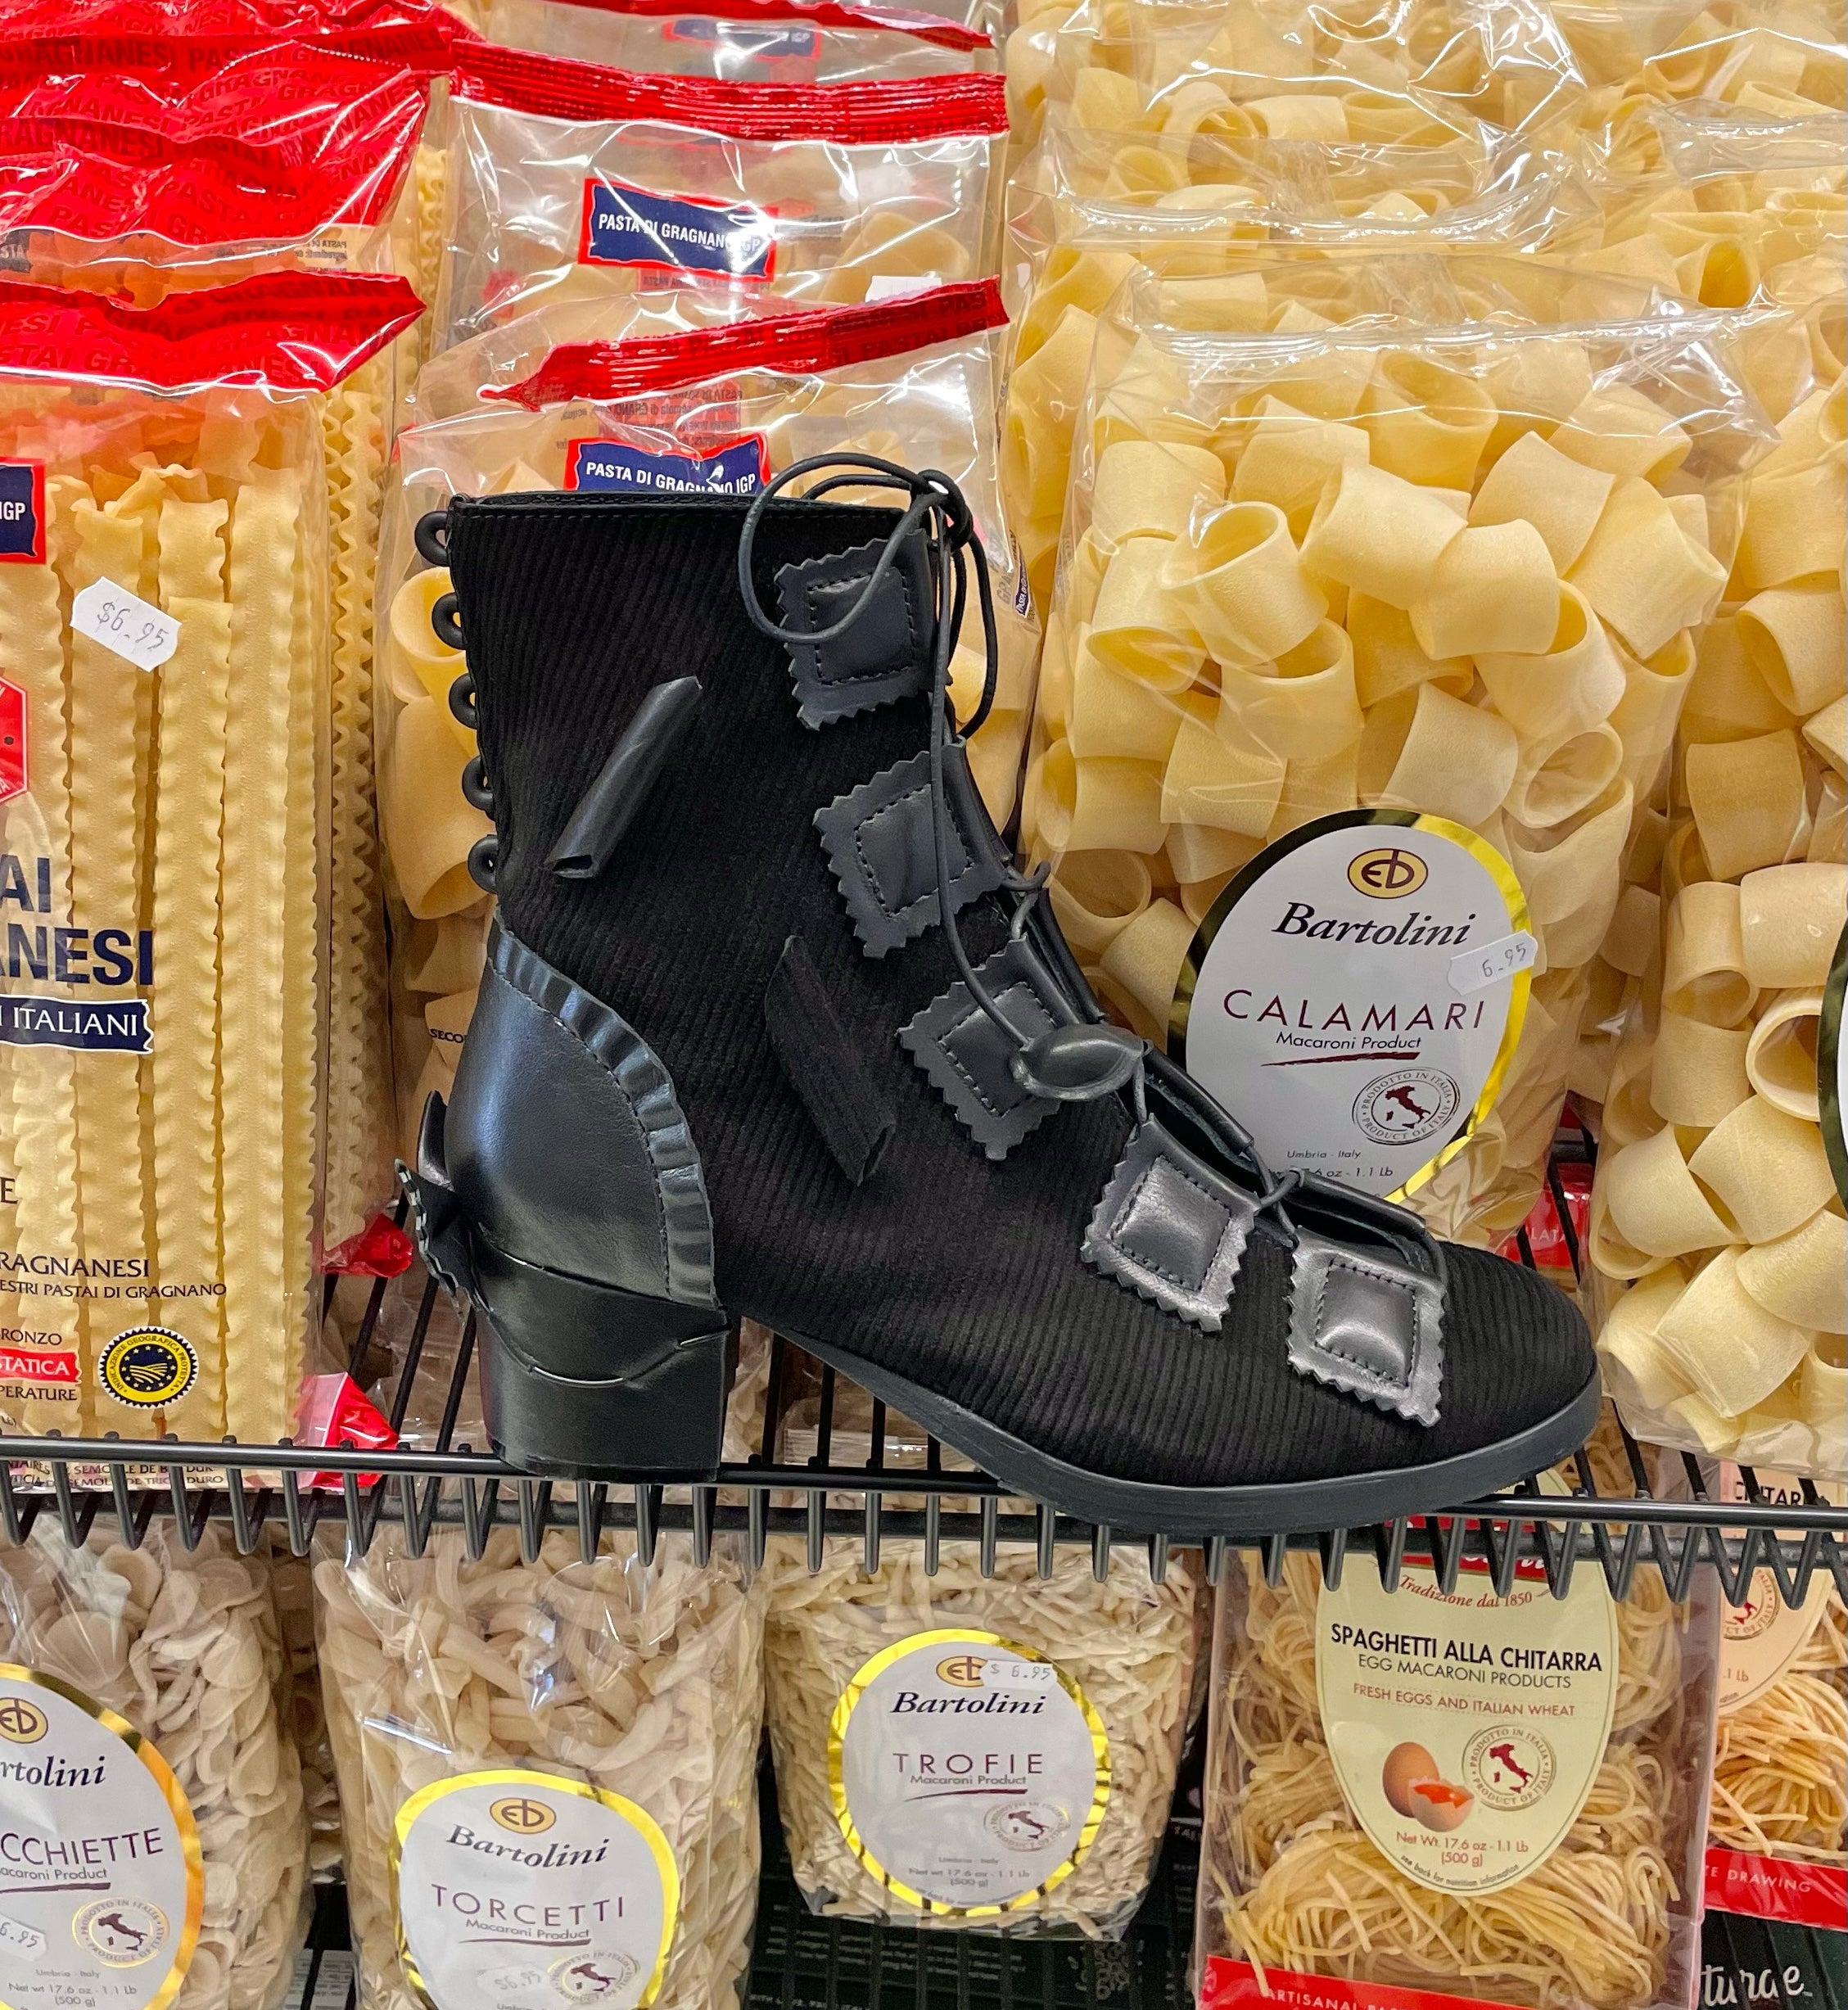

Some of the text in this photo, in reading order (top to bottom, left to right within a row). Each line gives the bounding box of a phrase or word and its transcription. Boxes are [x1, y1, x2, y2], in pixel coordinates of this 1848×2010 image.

[599, 213, 640, 233] PASTA
[662, 223, 730, 248] GRAGNAN
[585, 462, 631, 481] PASTA
[636, 468, 652, 486] DI
[736, 472, 756, 494] IGP
[97, 602, 169, 650] $6.95
[0, 854, 52, 914] AI
[1271, 901, 1476, 946] Bartolini
[0, 923, 153, 986] NESI
[1481, 942, 1527, 978] 6.95
[13, 1006, 138, 1037] ITALIANI
[1222, 989, 1485, 1032] CALAMARI
[430, 1028, 466, 1044] SECO
[1276, 1031, 1421, 1050] Macaroni Product
[1361, 1072, 1453, 1110] PRODOTTO IN ITALIA
[1361, 1105, 1452, 1141] PRODUCT OF ITALY
[1287, 1149, 1362, 1159] Umbria Italy
[1326, 1169, 1342, 1177] oz
[1356, 1167, 1373, 1177] 1.1
[1380, 1166, 1394, 1177] Lb
[0, 1279, 227, 1299] ESTRI PASTAI DI GRAGNANO
[0, 1328, 62, 1346] RONZO
[127, 1335, 179, 1351] GEOGRAFICA
[0, 1356, 70, 1375] TATICA
[69, 1477, 114, 1487] SEMOL
[187, 1475, 224, 1484] DURO
[140, 1464, 156, 1474] DE
[1476, 1592, 1499, 1608] dal
[1504, 1592, 1533, 1607] 1850
[1331, 1622, 1602, 1672] SPAGHETTI ALLA CHITARRA
[1011, 1664, 1051, 1680] 6.95
[1358, 1654, 1572, 1689] EGG MACARONI PRODUCTS
[889, 1691, 1047, 1714] Bartolini
[1353, 1683, 1575, 1718] FRESH EGGS AND ITALIAN WHEAT
[1470, 1728, 1548, 1767] PRODOTTO IN ITALIA
[892, 1753, 1042, 1775] TROFIE
[910, 1774, 1027, 1786] Macaroni Product
[1473, 1768, 1550, 1805] PRODUCT OF ITALY
[1, 1827, 163, 1866] CCHIETTE
[445, 1823, 610, 1868] Bartolini
[1396, 1831, 1417, 1845] Net
[1444, 1837, 1469, 1850] 17.6
[1473, 1843, 1487, 1851] oz
[1441, 1851, 1484, 1868] (500 g)
[55, 1867, 107, 1881] Product
[1727, 1869, 1812, 1894] DRAWING
[432, 1884, 623, 1926] TORCETTI
[465, 1917, 590, 1941] Macaroni Product
